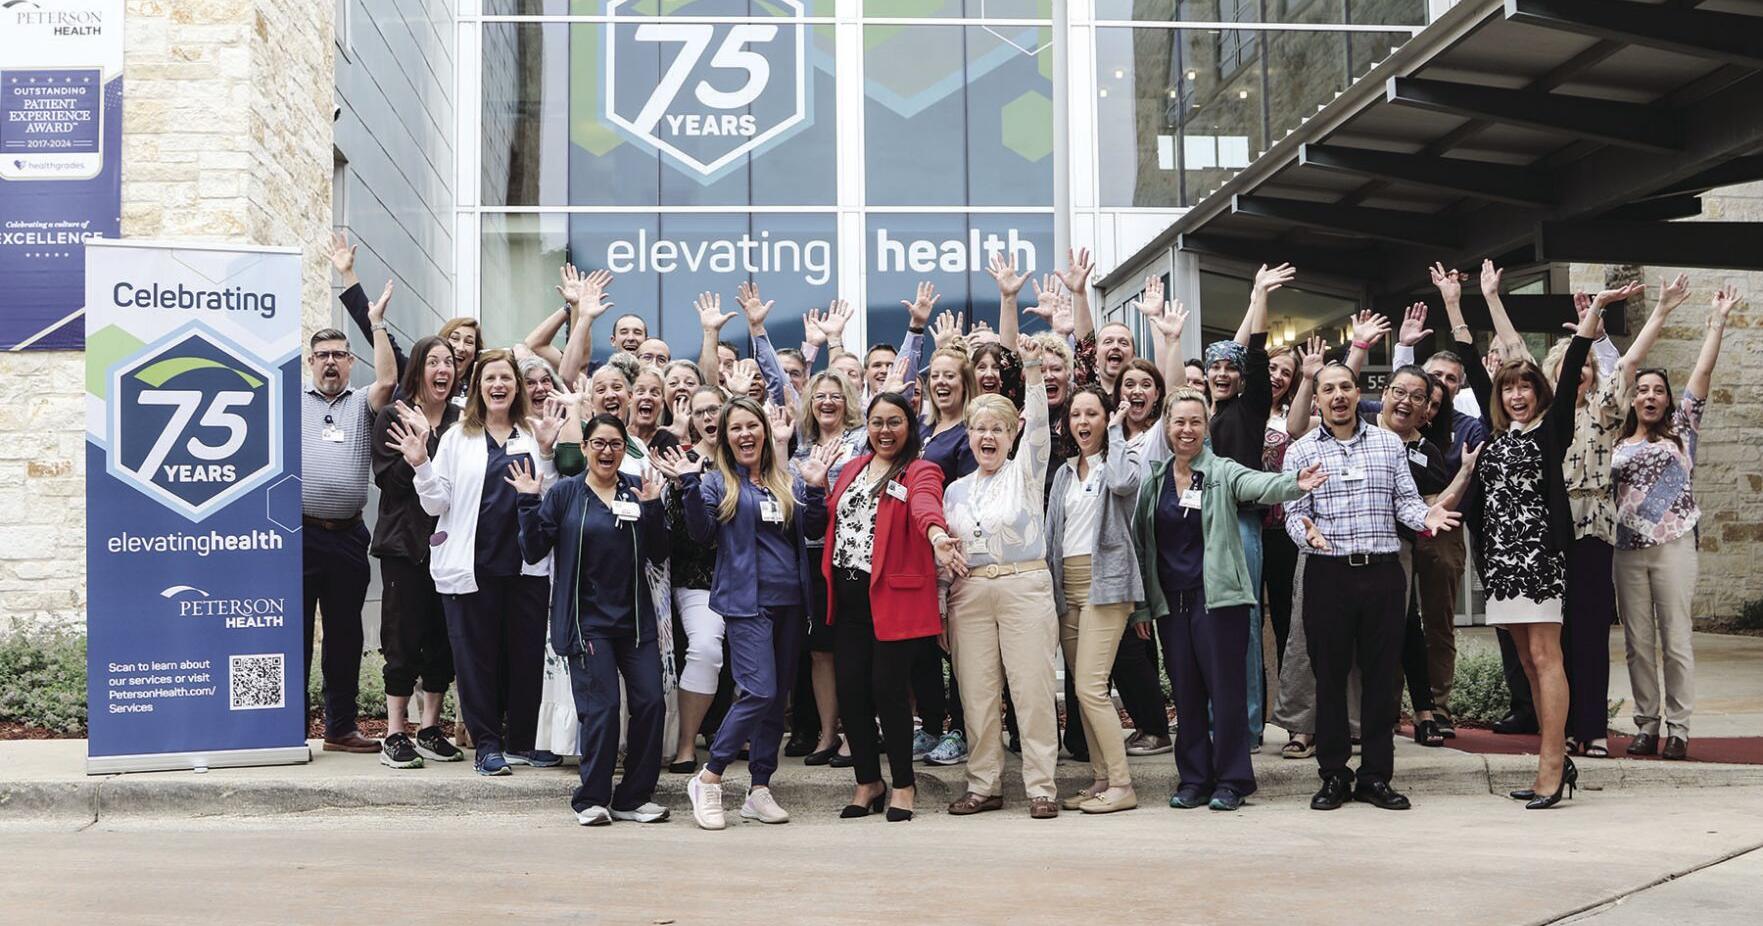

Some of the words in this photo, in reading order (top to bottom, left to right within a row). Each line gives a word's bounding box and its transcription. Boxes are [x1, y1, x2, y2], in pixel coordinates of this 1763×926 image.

[17, 11, 102, 25] PETERSON
[54, 26, 102, 35] HEALTH
[634, 24, 779, 134] 75
[14, 87, 87, 95] OUTSTANDING
[23, 99, 77, 109] PATIENT
[9, 110, 91, 121] EXPERIENCE
[666, 114, 757, 136] YEARS
[5, 221, 48, 229] Celebrating
[0, 232, 103, 245] XCELLENC
[607, 229, 831, 286] elevating
[877, 229, 1036, 272] health
[113, 282, 277, 319] Celebrating
[136, 390, 256, 481] 75
[163, 465, 237, 482] YEARS
[107, 530, 283, 557] elevatinghealth
[179, 598, 285, 616] PETERSON
[225, 616, 284, 629] HEALTH
[108, 662, 136, 673] Scan
[137, 661, 149, 672] to
[151, 660, 178, 672] learn
[179, 659, 211, 671] about
[108, 678, 127, 686] our
[128, 675, 173, 686] services
[174, 676, 187, 684] or
[188, 673, 211, 684] visit
[108, 686, 217, 701] PetersonHealth.com/
[108, 703, 154, 714] Services
